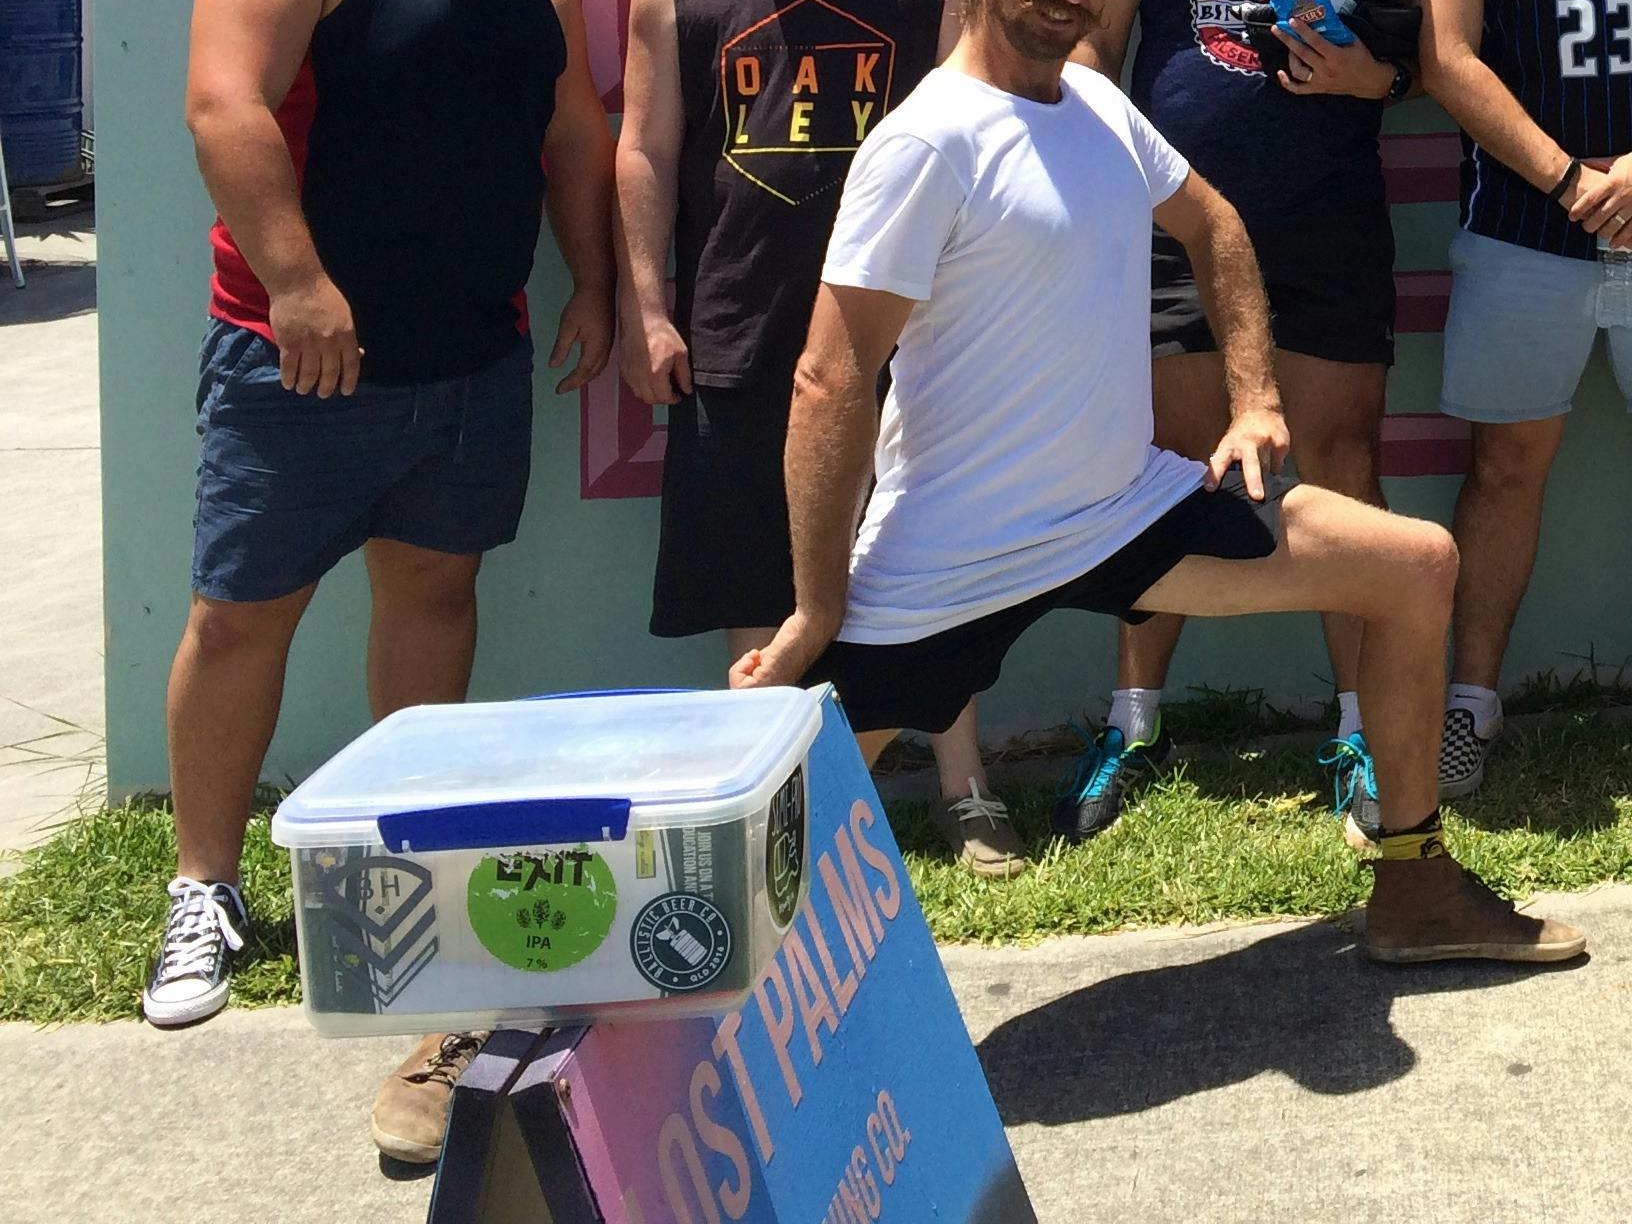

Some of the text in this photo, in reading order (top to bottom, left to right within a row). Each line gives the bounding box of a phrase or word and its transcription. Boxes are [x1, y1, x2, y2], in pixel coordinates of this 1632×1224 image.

[496, 849, 593, 891] EXIT
[698, 853, 713, 866] US
[525, 935, 552, 950] IPA
[637, 910, 664, 979] BALLISTIC
[661, 898, 696, 914] BEER
[689, 945, 725, 983] QLD 2016
[624, 1011, 774, 1224] OST
[753, 798, 901, 1110] PALMS
